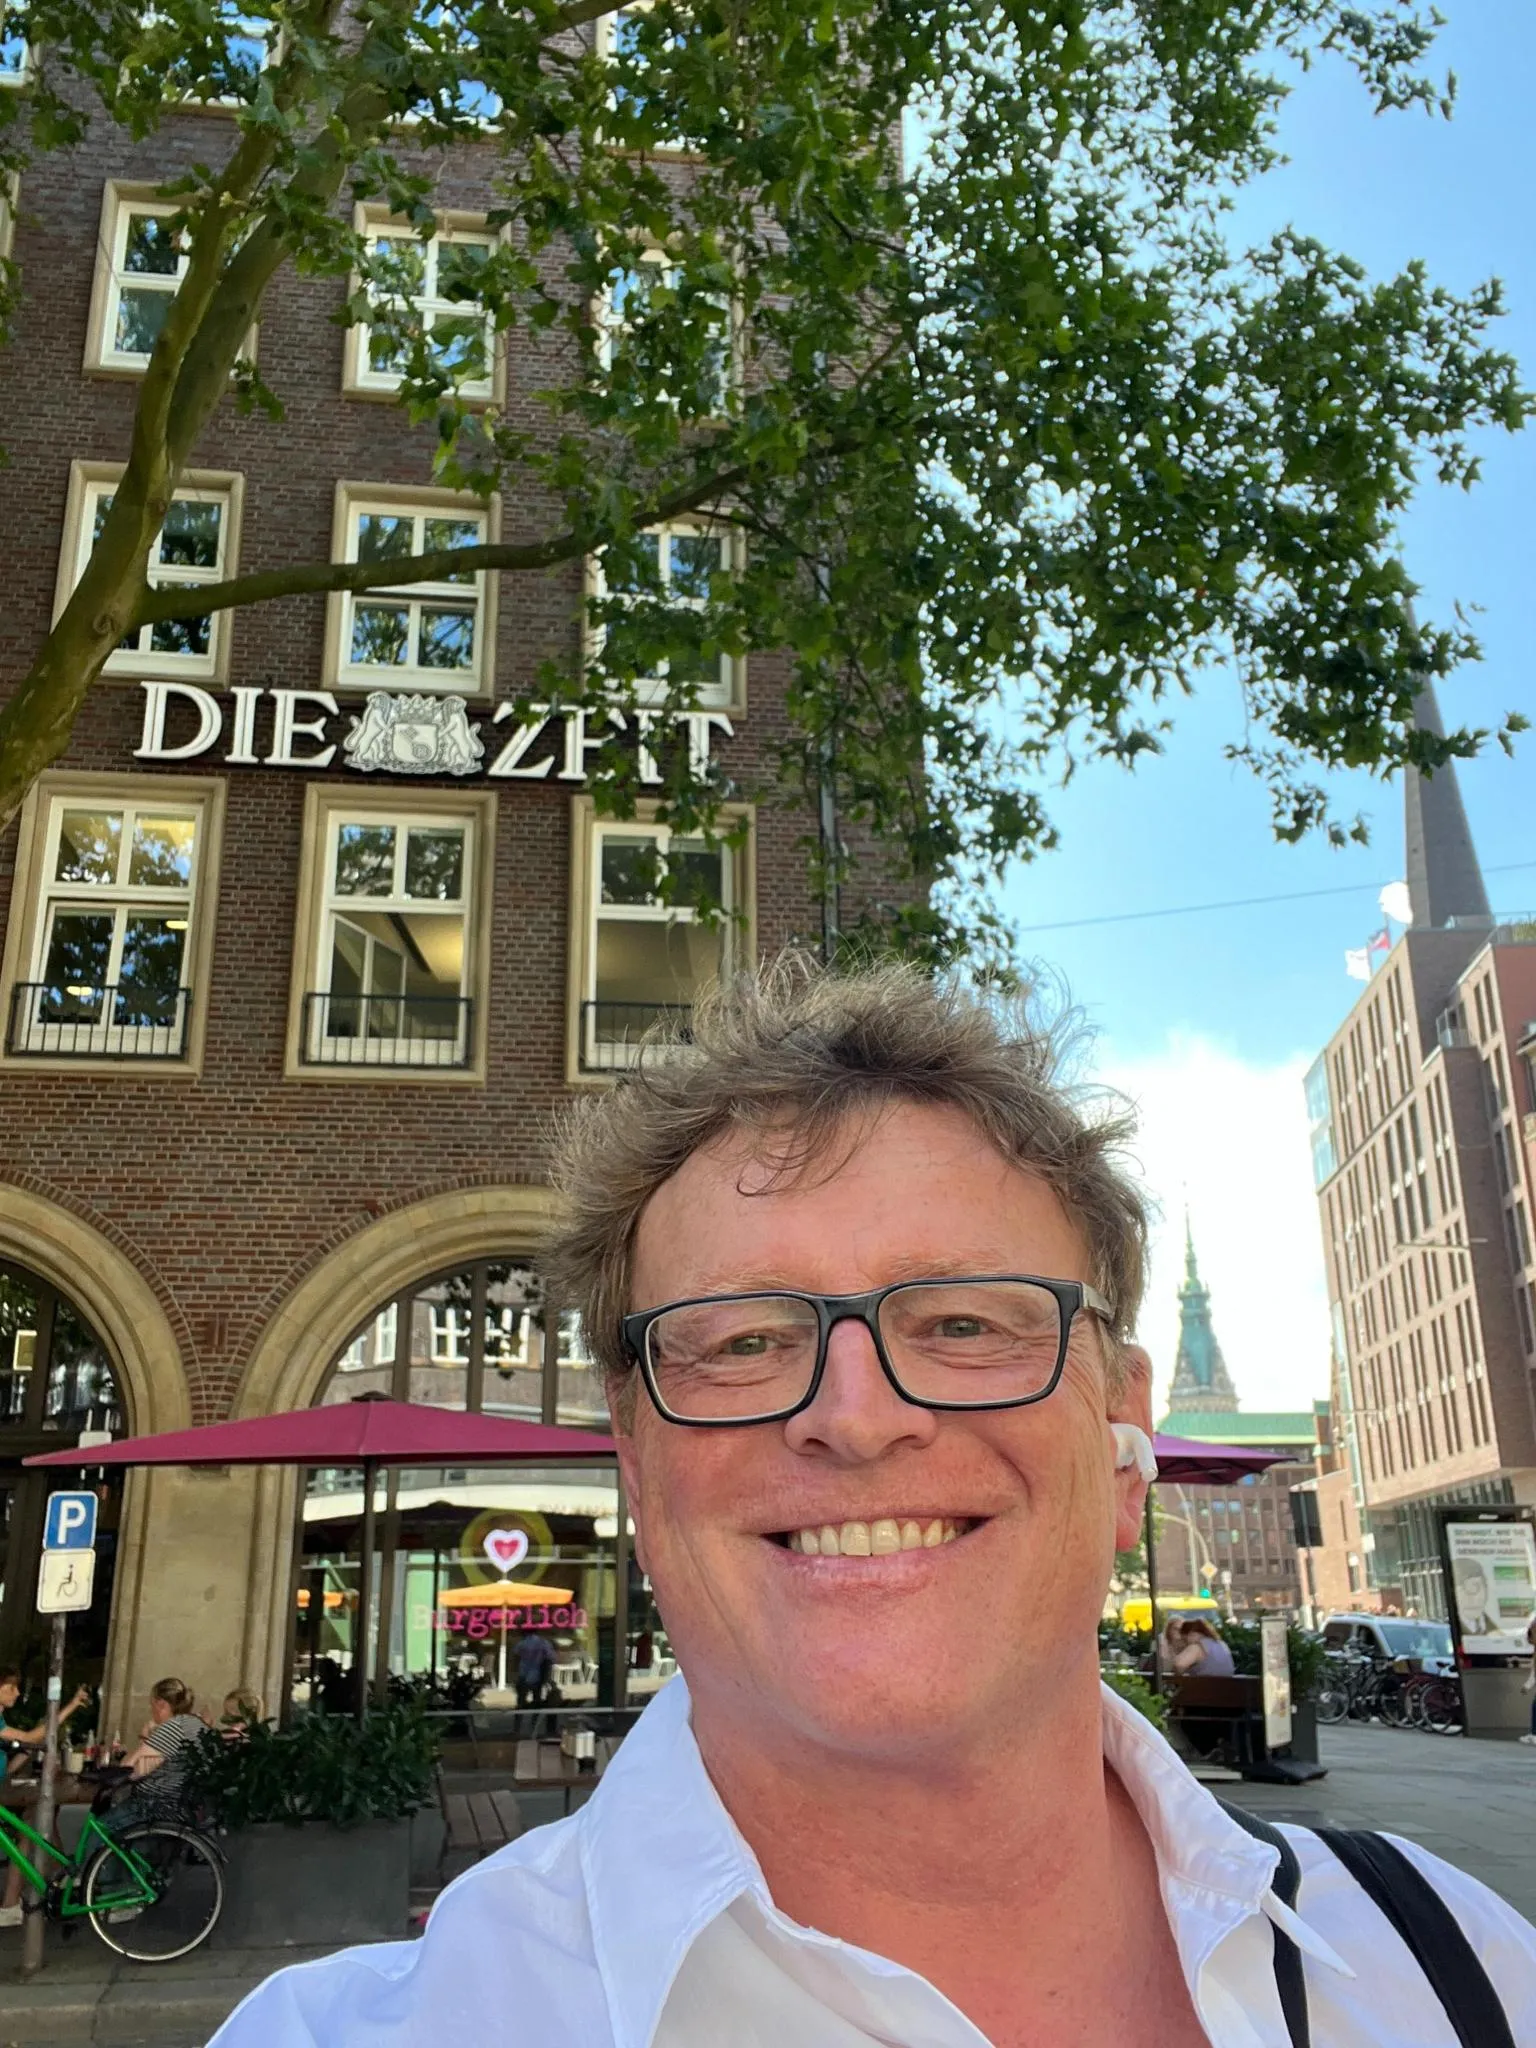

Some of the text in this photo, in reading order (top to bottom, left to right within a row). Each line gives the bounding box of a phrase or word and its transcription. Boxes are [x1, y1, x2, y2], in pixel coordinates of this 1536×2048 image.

[133, 681, 735, 787] DIE ZEIT
[57, 1500, 87, 1545] P
